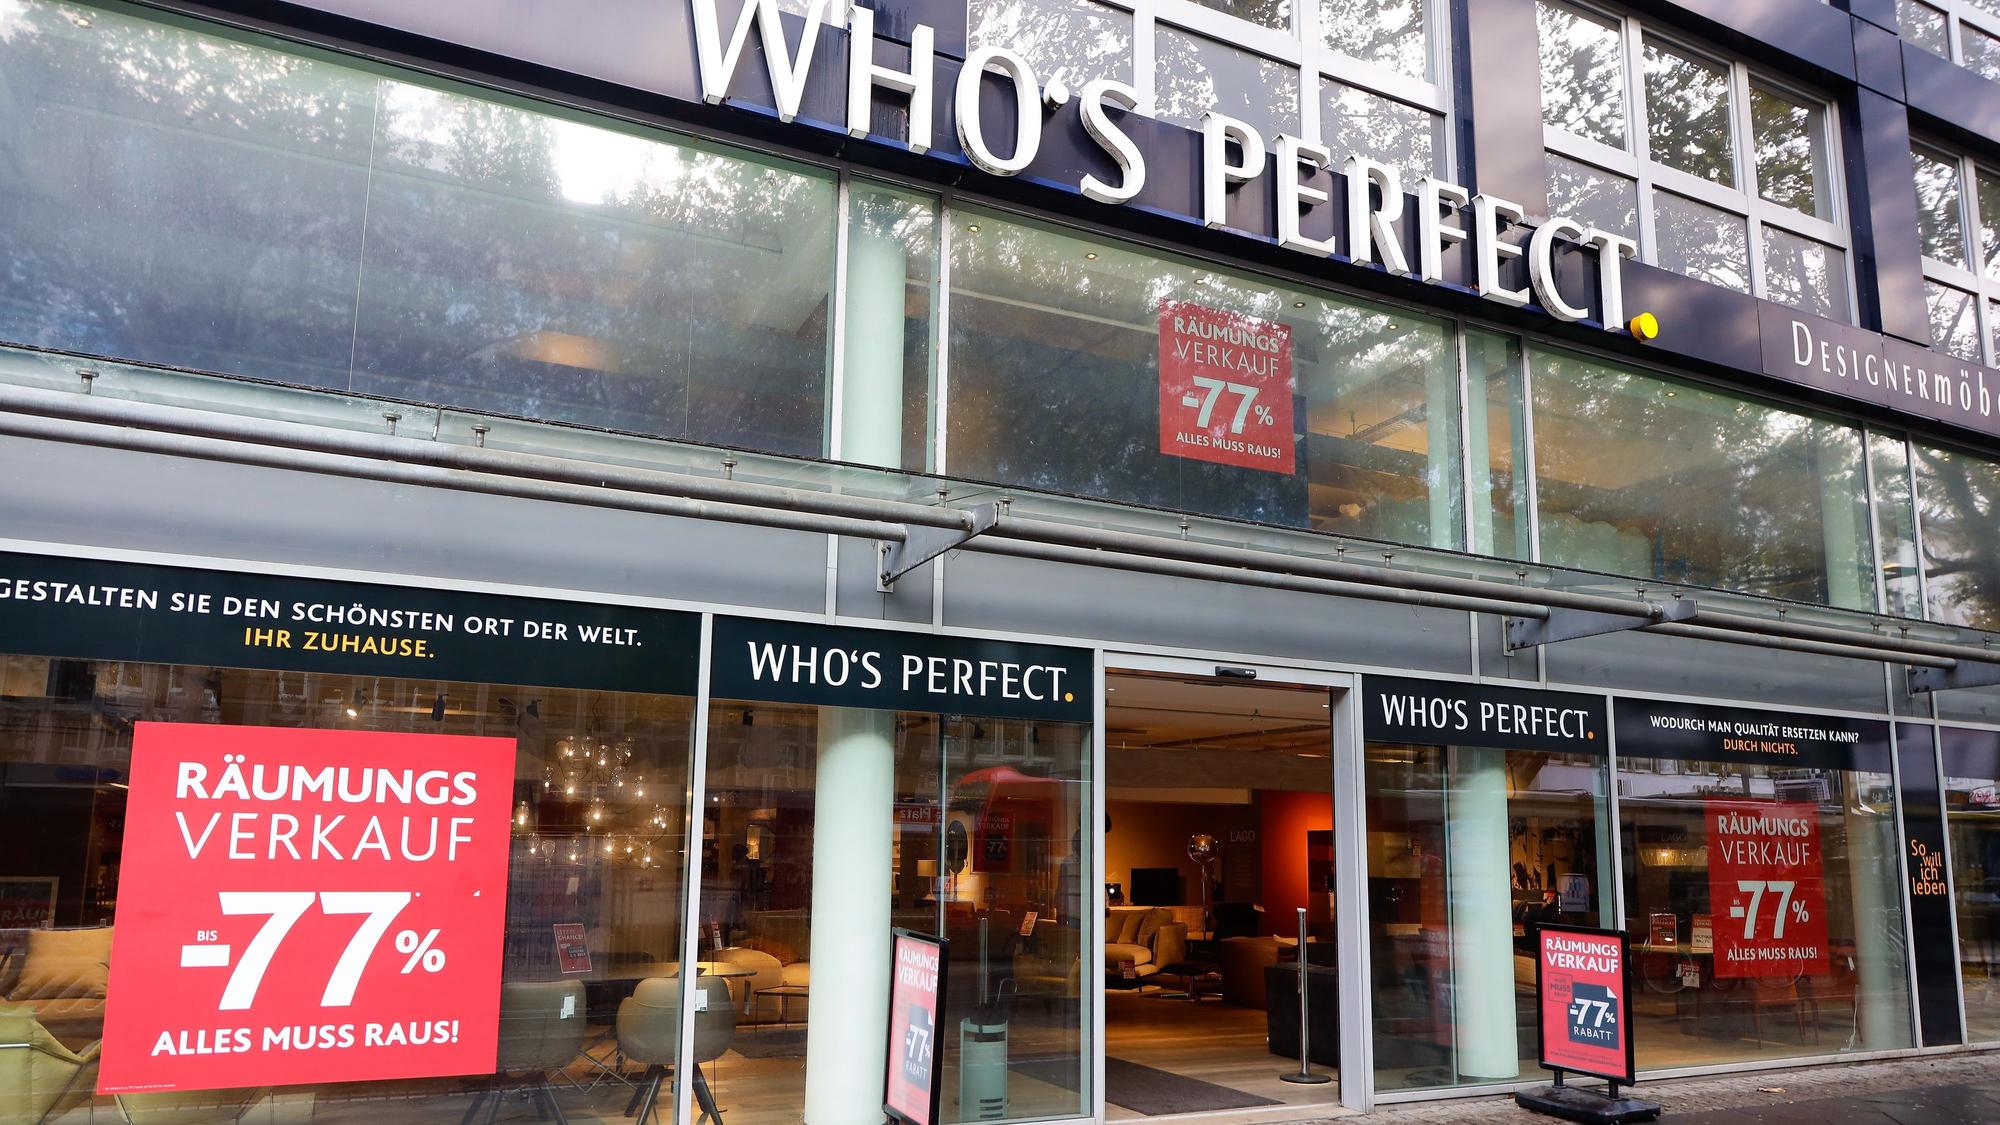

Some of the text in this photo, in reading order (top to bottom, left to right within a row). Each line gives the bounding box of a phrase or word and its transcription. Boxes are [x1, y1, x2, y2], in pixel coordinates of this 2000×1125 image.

[1200, 111, 1659, 343] PERFECT.
[1174, 315, 1279, 353] RÄUMUNGS
[1175, 337, 1279, 377] VERKAUF
[1792, 320, 2000, 417] DESIGNERmöb
[1176, 431, 1281, 458] ALLES MUSS RAUS!
[0, 578, 642, 647] GESTALTEN SIE DEN SCHÖNSTEN ORT DER WELT.
[244, 627, 435, 659] IHR ZUHAUSE.
[902, 654, 1073, 702] PERFECT.
[1480, 701, 1594, 740] PERFECT.
[1650, 715, 1859, 743] WODURCH MAN QUALITÄT ERSETZEN KANN?
[1724, 738, 1798, 755] DURCH NICHTS.
[175, 754, 477, 806] RÄUMUNGS
[175, 811, 475, 862] VERKAUF
[1718, 811, 1809, 837] RÄUMUNGS
[1720, 840, 1810, 866] VERKAUF
[1911, 839, 1926, 856] So
[1923, 851, 1942, 867] will
[1912, 876, 1946, 895] leben
[1920, 863, 1938, 881] ich
[197, 930, 218, 942] BIS
[1546, 936, 1618, 957] RÄUMUNGS
[898, 946, 939, 972] RÄUMUNGS
[1546, 951, 1619, 974] VERKAUF
[1727, 947, 1818, 961] ALLES MUSS RAUS!
[151, 1020, 459, 1056] ALLES MUSS RAUS!
